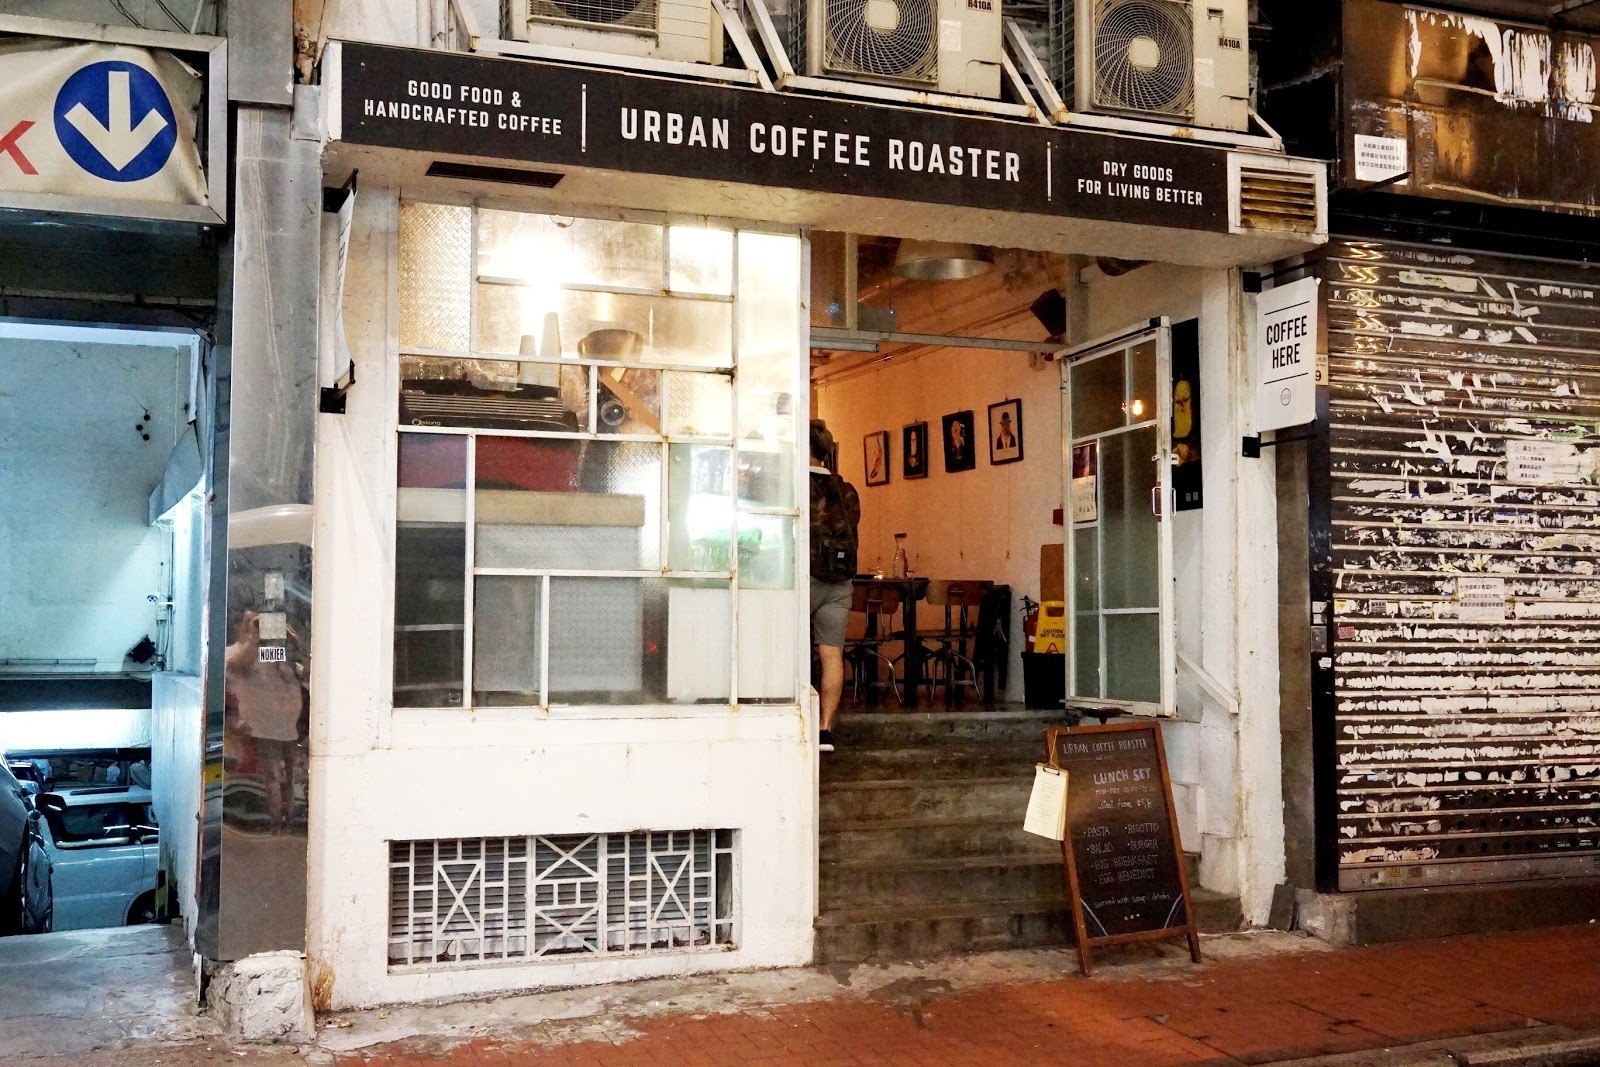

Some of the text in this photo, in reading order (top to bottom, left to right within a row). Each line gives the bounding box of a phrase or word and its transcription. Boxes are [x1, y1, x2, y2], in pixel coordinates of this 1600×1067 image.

[967, 0, 992, 10] R410A
[1218, 37, 1241, 49] R410A
[408, 79, 522, 108] GOOD FOOD &
[364, 98, 562, 135] HANDCRAFTED COFFEE
[621, 107, 1020, 182] URBAN COFFEE ROASTER
[1103, 160, 1174, 183] DRY GOODS
[1077, 178, 1203, 206] FOR LIVING BETTER
[1266, 315, 1308, 346] COFFEE
[1272, 343, 1301, 369] HERE
[260, 648, 285, 661] NOKIER
[1063, 738, 1149, 755] URBAN COFFEE ROASTER
[1093, 767, 1151, 785] LUNCH SET
[1087, 826, 1111, 838] PASTA
[1127, 822, 1159, 835] RISOTTO
[1130, 839, 1159, 850] BURGER
